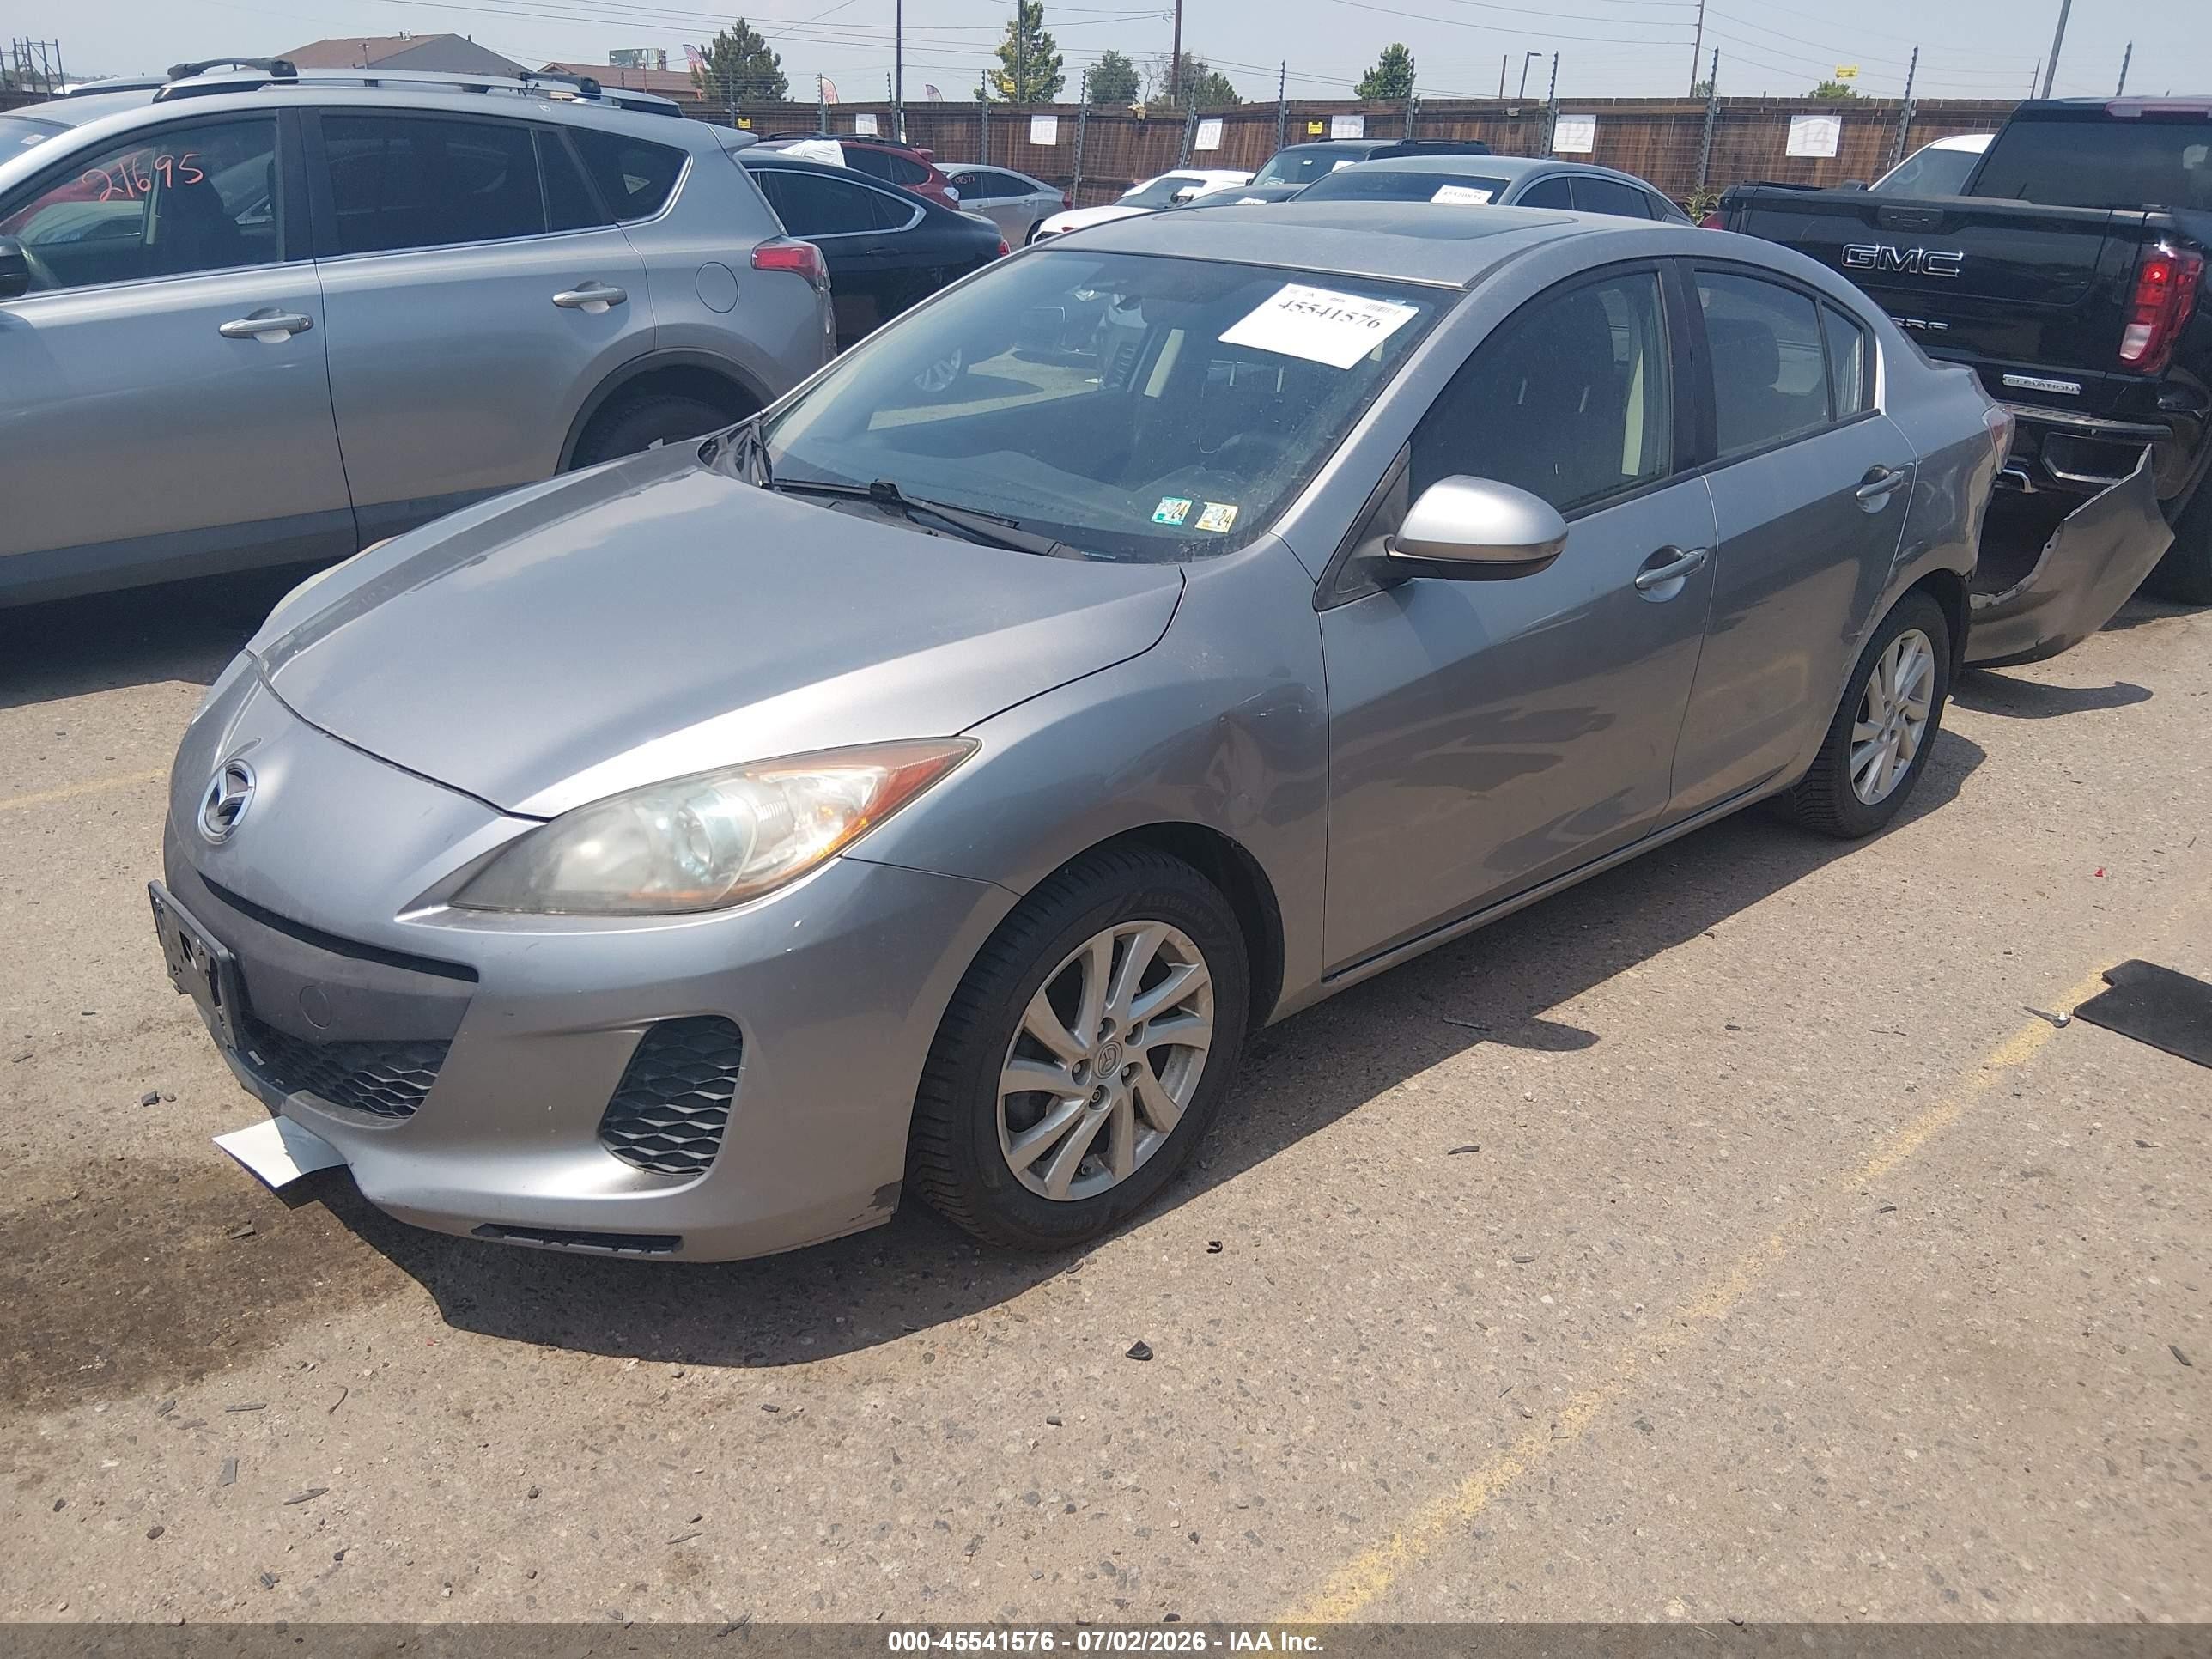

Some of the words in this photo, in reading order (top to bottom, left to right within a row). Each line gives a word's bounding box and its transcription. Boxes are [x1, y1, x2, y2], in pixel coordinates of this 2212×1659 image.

[1800, 123, 1830, 150] 14
[82, 154, 204, 203] 21695
[1841, 243, 1963, 277] GMC
[1278, 299, 1382, 330] 45541576
[2008, 378, 2075, 392] ELEVATION
